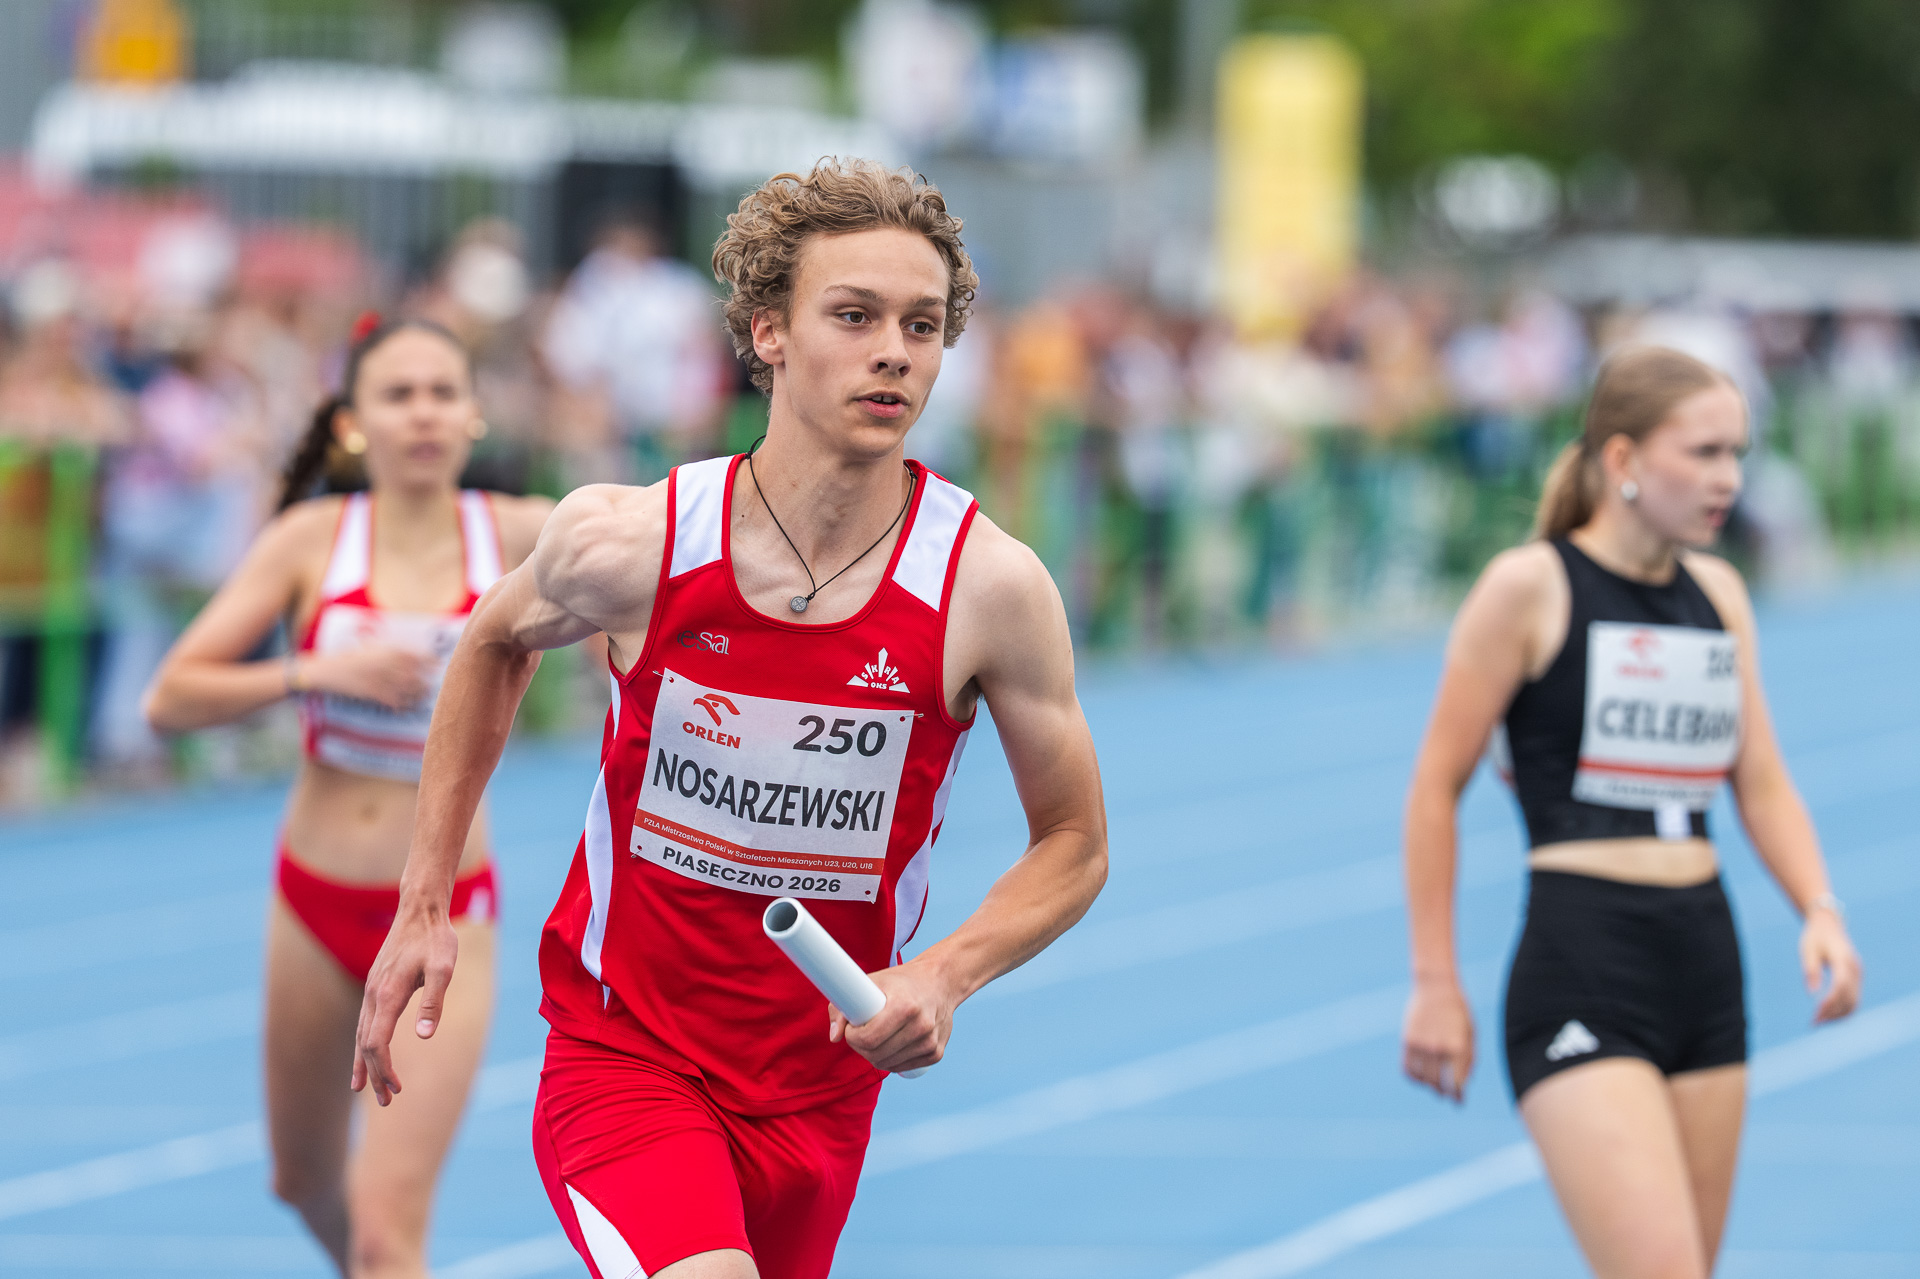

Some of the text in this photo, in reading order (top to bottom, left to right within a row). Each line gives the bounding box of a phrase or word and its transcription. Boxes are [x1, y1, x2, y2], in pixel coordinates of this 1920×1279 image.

[861, 664, 900, 685] SKRA
[870, 681, 887, 690] OKS
[682, 721, 741, 749] ORLEN
[793, 714, 887, 757] 250
[652, 748, 885, 831] NOSARZEWSKI
[643, 817, 660, 829] PZLA
[661, 824, 704, 845] Mistrzostwa
[705, 839, 727, 853] Polski
[735, 851, 776, 863] Sztafetach
[777, 857, 823, 867] Mieszanych
[824, 860, 840, 868] U23,
[841, 861, 858, 870] U20,
[662, 846, 842, 893] PIASECZNO 2026
